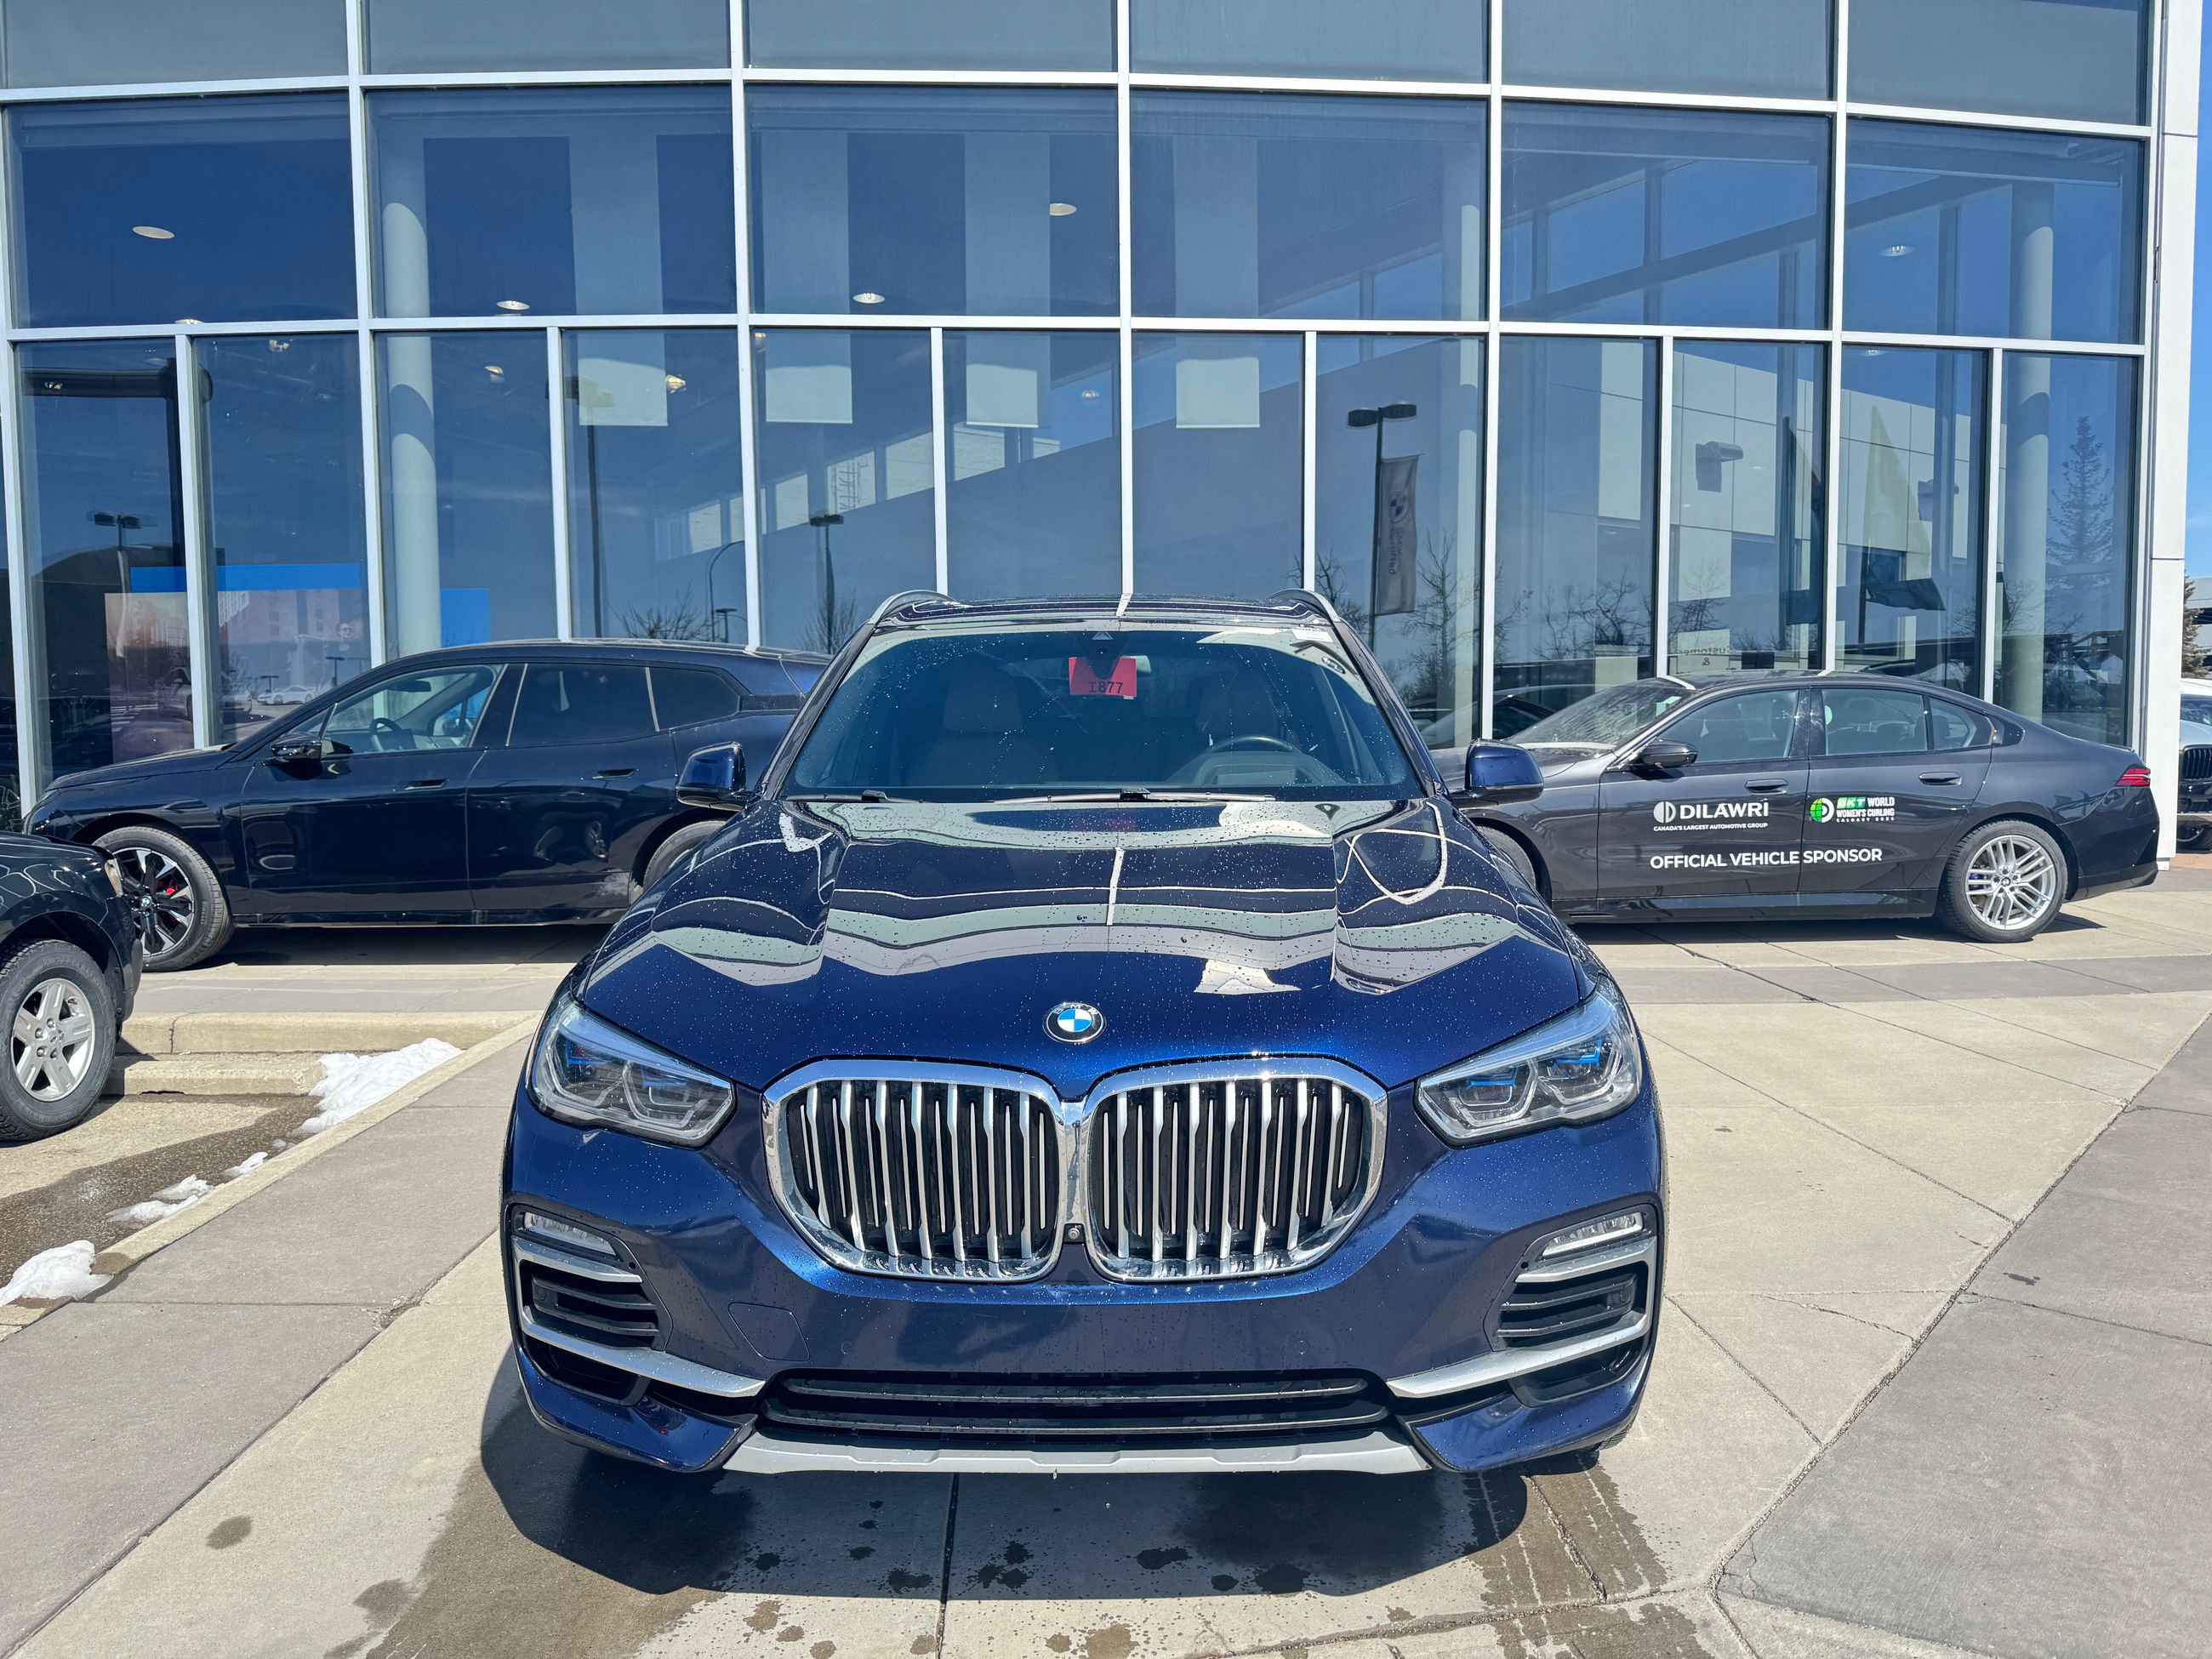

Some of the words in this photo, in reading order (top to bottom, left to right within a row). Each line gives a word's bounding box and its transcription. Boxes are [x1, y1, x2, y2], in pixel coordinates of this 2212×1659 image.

[1837, 797, 1866, 808] BKT
[1867, 796, 1896, 807] WORLD
[1679, 801, 1769, 819] DILAWRI
[1836, 808, 1867, 818] WOMEN'S
[1867, 807, 1896, 817] CURLING
[1650, 853, 1727, 869] OFFICIAL
[1730, 851, 1799, 867] VEHICLE
[1803, 847, 1883, 864] SPONSOR
